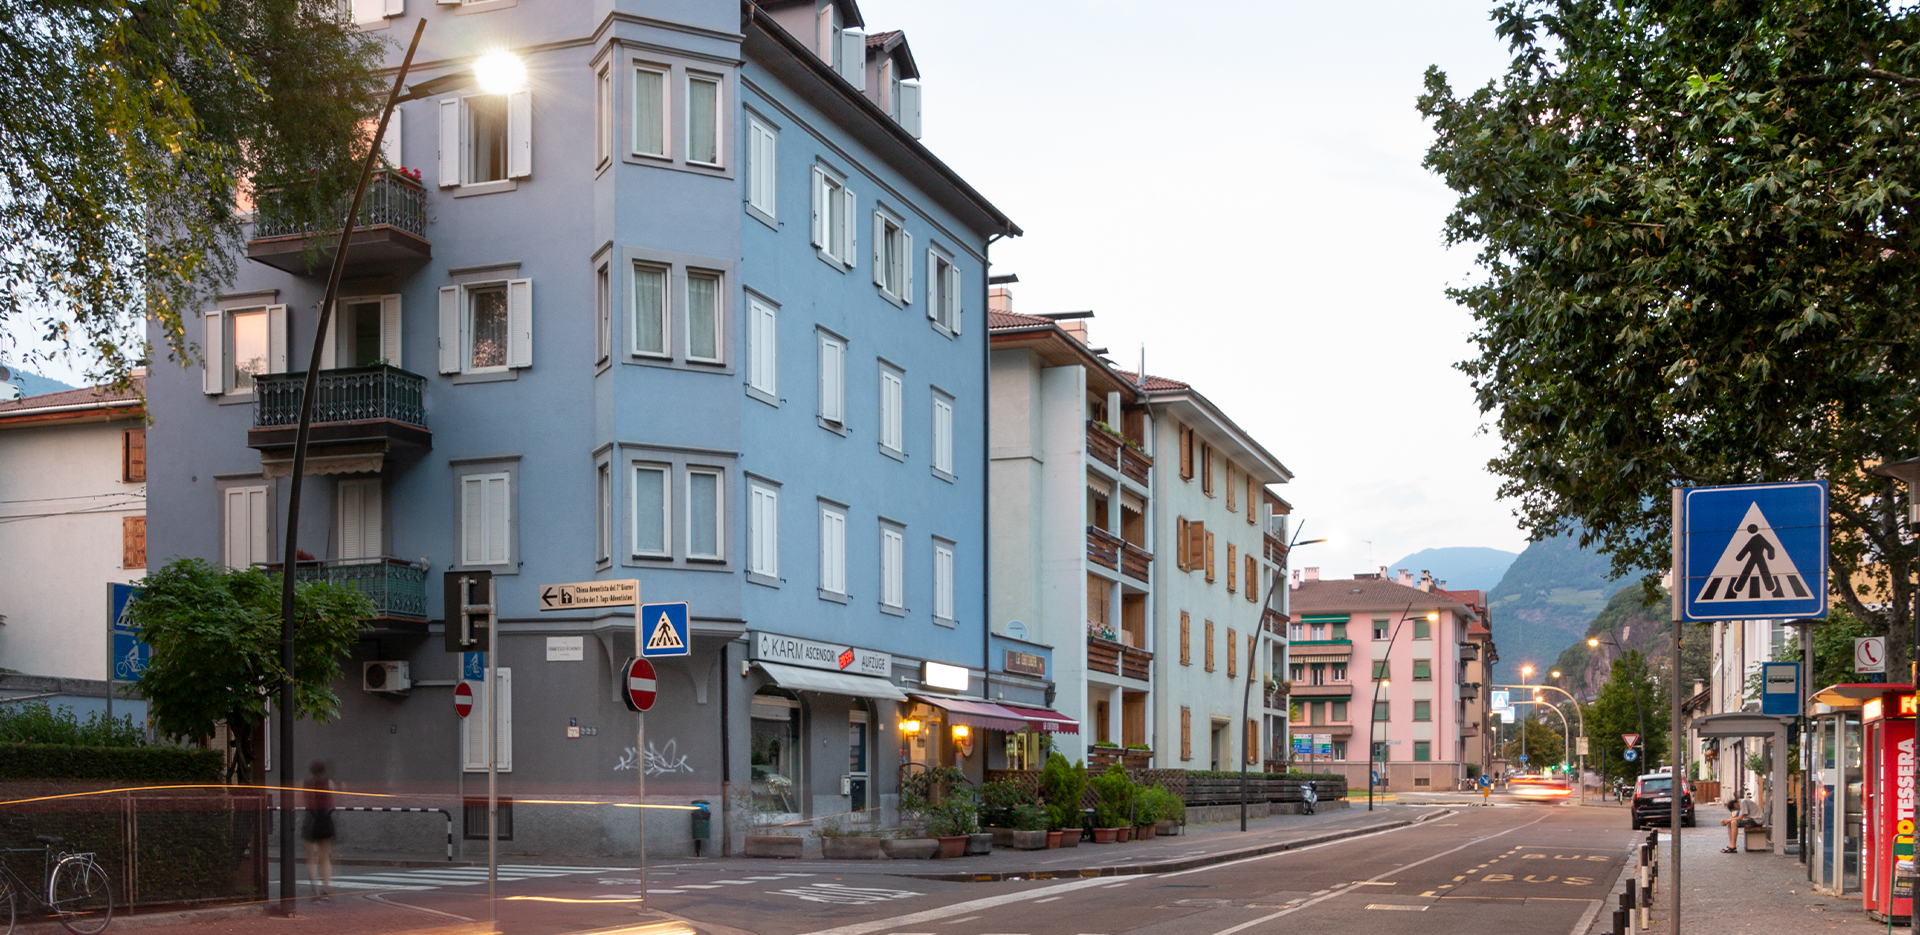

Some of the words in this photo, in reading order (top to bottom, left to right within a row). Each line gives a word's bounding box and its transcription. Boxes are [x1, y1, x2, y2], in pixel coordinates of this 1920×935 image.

[576, 586, 588, 594] Chiesa
[621, 583, 634, 591] Giorno
[576, 596, 589, 604] Kirche
[772, 638, 804, 660] KARM
[805, 646, 836, 663] ASCENSORI
[862, 654, 885, 670] AUFZÜGE
[1521, 853, 1610, 862] BUS
[1481, 873, 1595, 886] BUS
